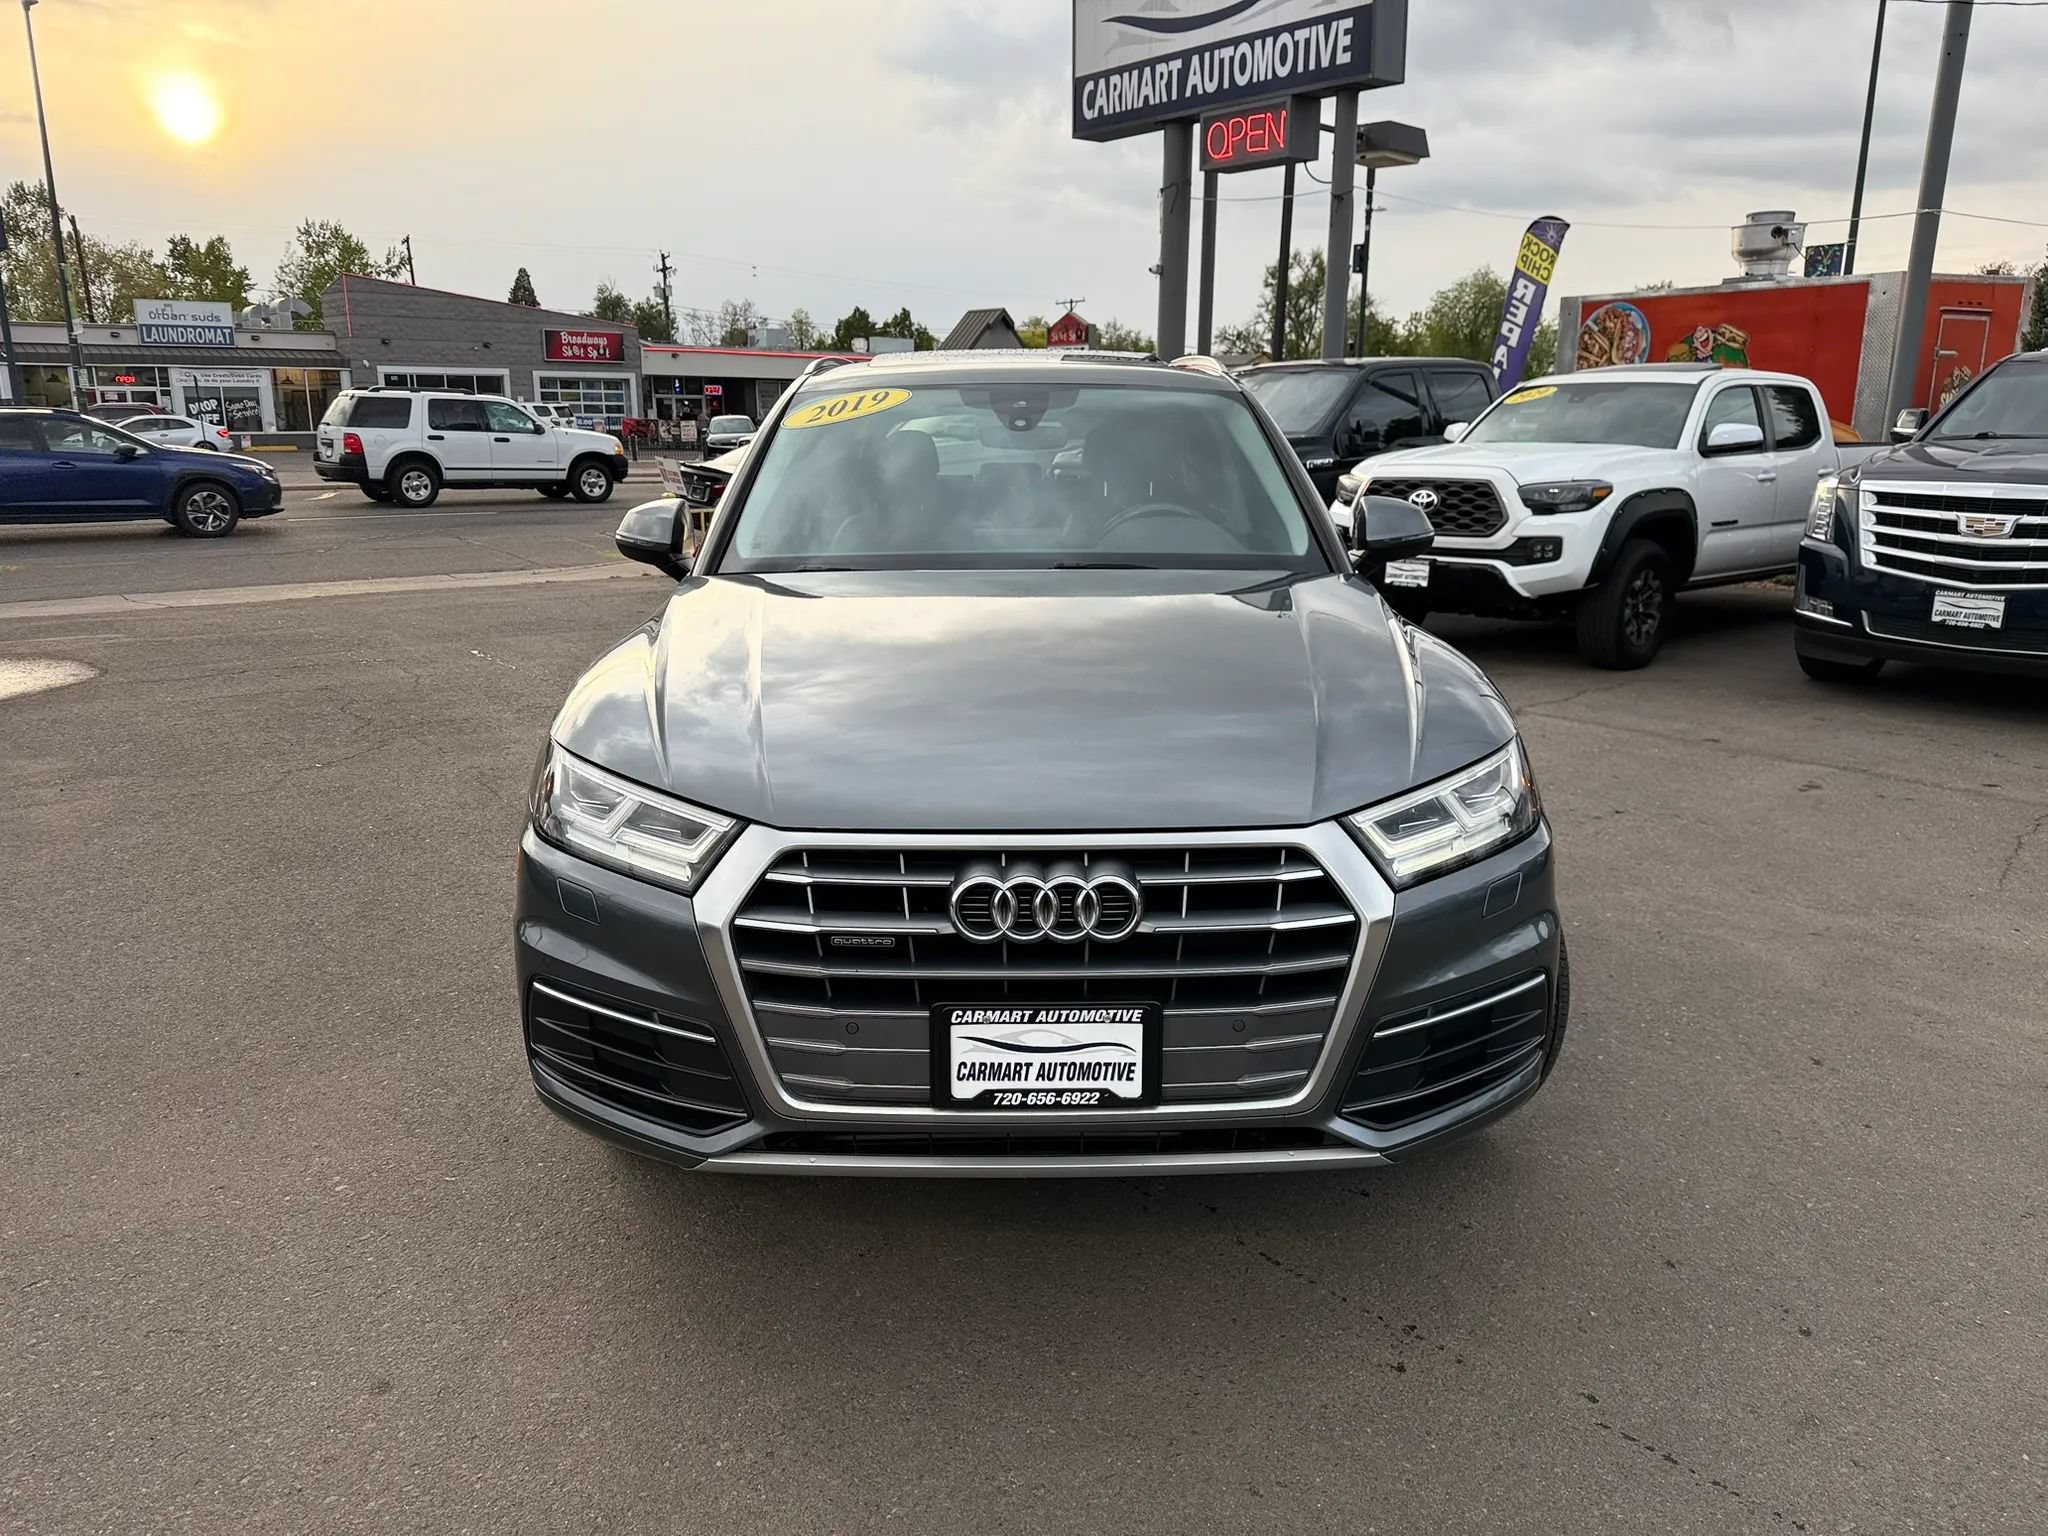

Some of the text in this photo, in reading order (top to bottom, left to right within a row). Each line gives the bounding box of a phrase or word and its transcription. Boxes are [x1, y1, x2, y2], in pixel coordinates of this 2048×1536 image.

[1082, 17, 1354, 120] CARMART AUTOMOTIVE
[1207, 110, 1287, 160] OPEN
[191, 312, 222, 322] suds
[142, 326, 231, 344] LAUNDROMAT
[560, 331, 608, 346] Broadways
[115, 375, 136, 383] OPEN
[188, 399, 218, 415] DROP
[805, 391, 890, 424] 2019
[1935, 590, 1965, 598] CARMART
[1934, 609, 2001, 623] CARMART AUTOMOTIVE
[951, 1009, 1143, 1024] CARMART AUTOMOTIVE
[956, 1061, 1137, 1082] CARMART AUTOMOTIVE
[993, 1092, 1101, 1105] 720-656-6922
